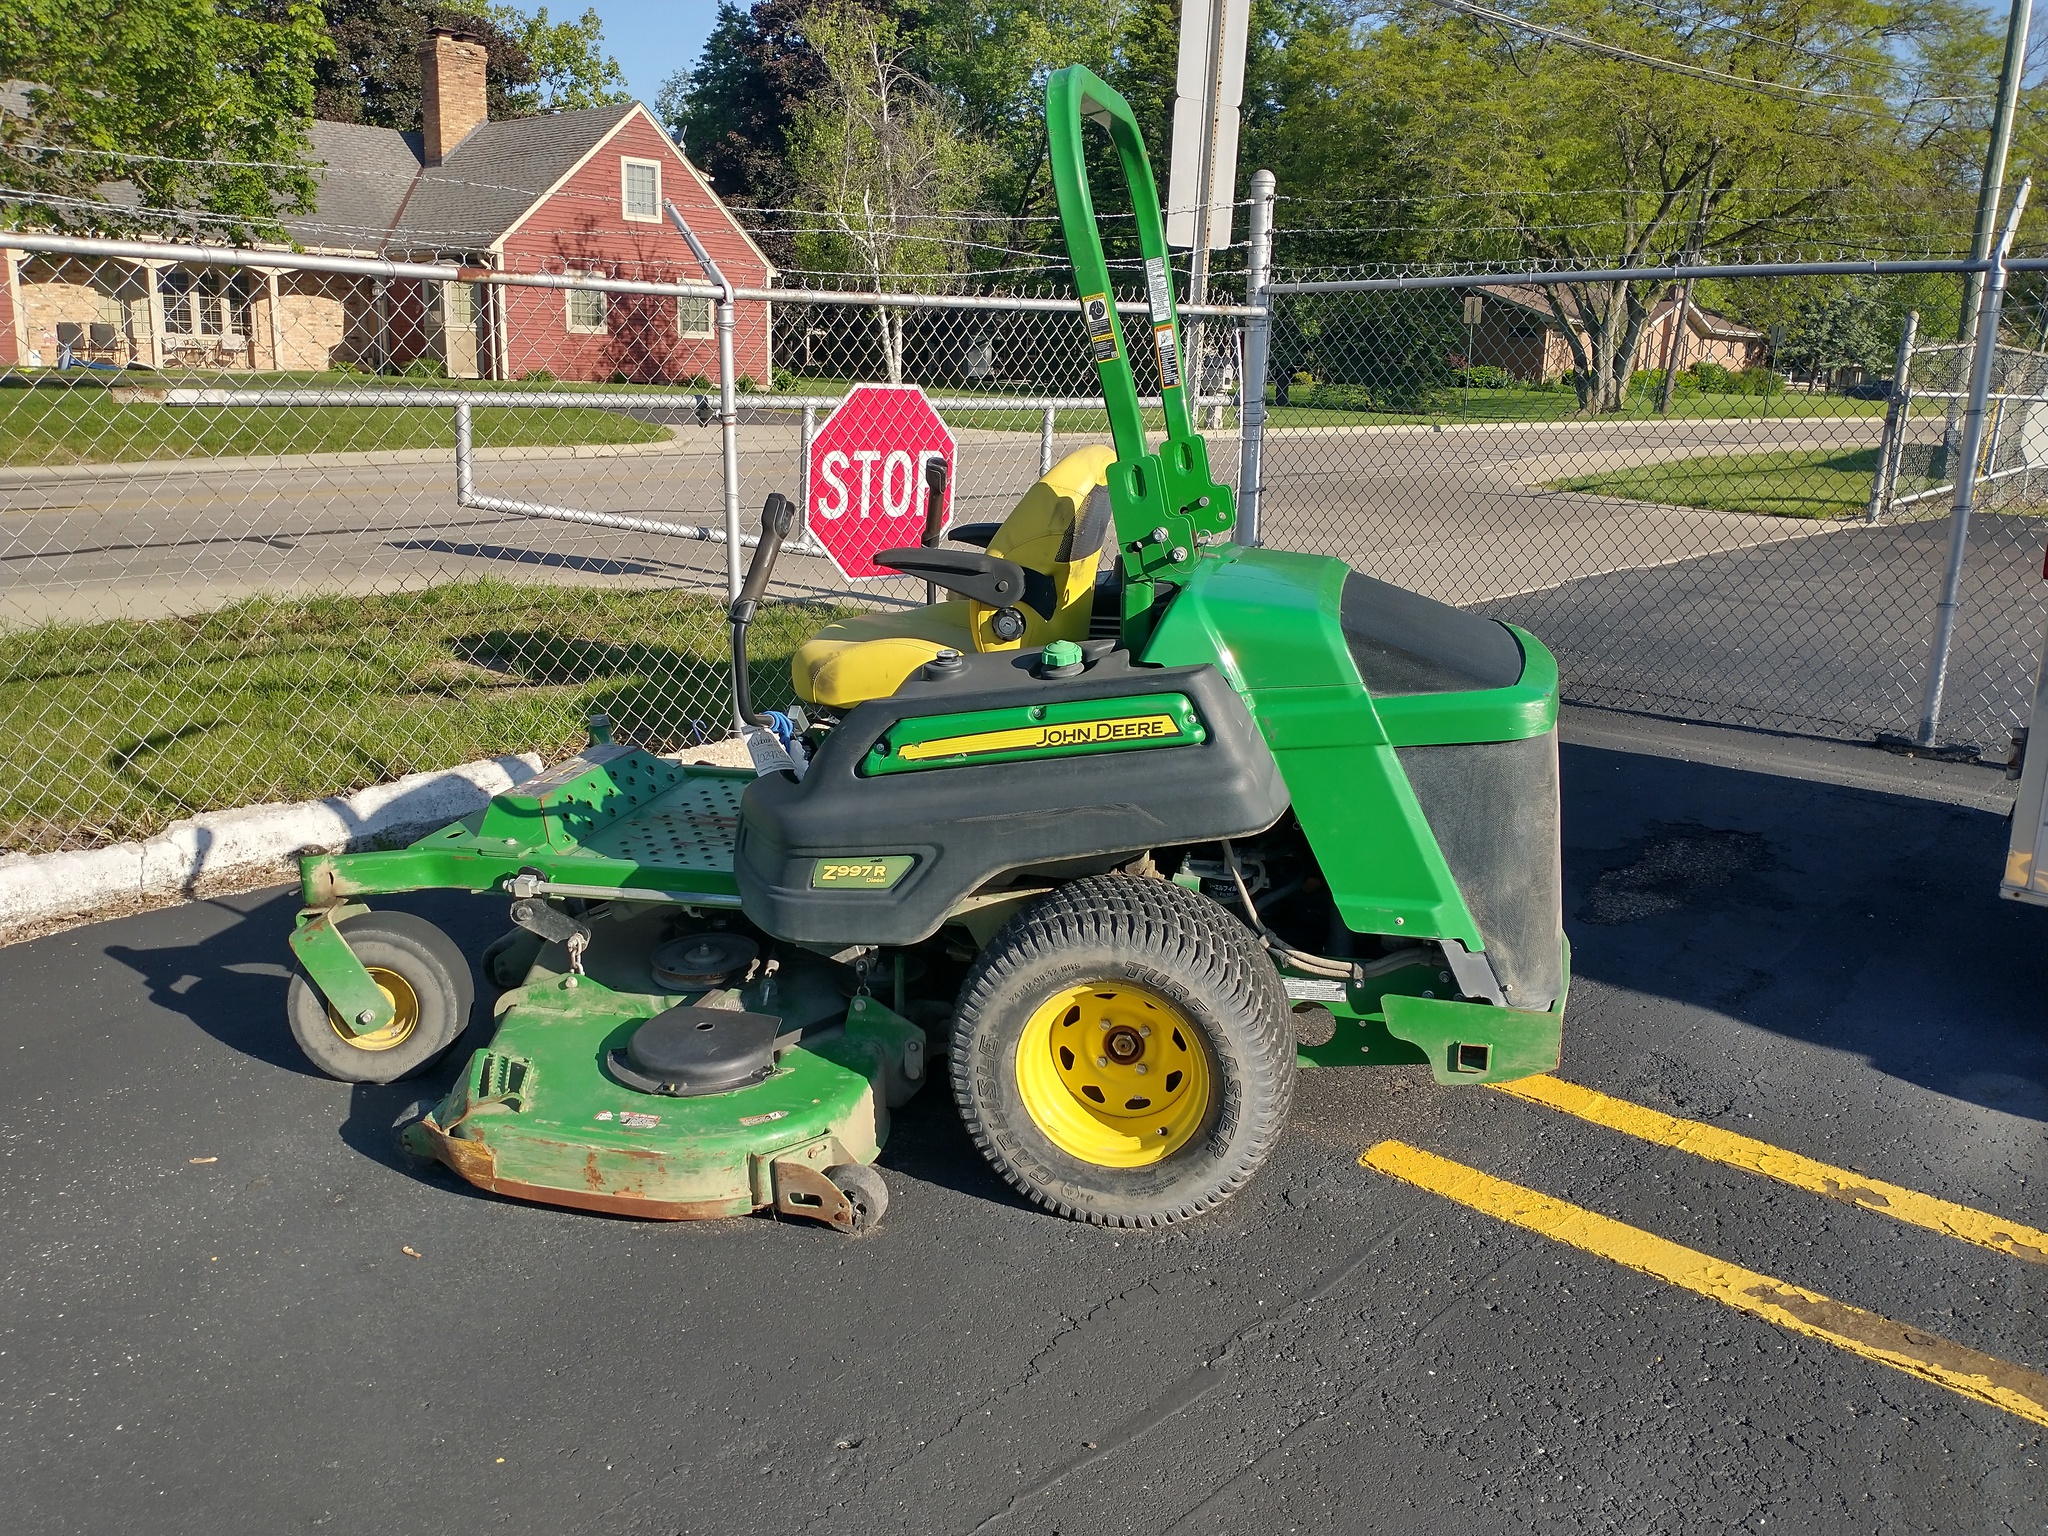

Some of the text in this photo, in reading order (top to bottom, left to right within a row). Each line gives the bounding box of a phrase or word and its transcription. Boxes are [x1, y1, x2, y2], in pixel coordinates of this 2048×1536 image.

[818, 450, 943, 519] STOP
[1036, 721, 1163, 745] JOHN DEERE
[822, 865, 887, 881] Z997R
[976, 1034, 1057, 1186] CARLISLE
